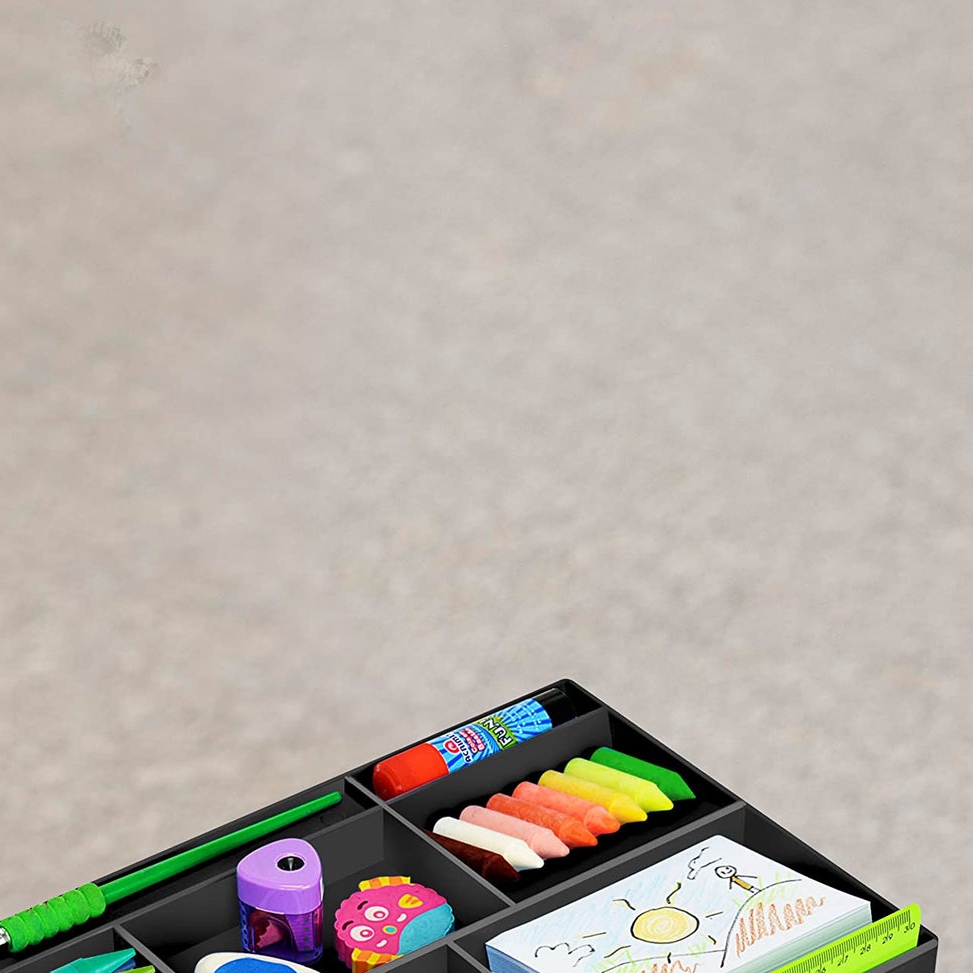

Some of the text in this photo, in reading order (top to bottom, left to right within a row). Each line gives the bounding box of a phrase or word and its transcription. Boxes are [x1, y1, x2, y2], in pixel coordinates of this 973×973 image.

[837, 954, 848, 966] 27
[860, 944, 871, 955] 28
[882, 933, 894, 944] 29
[903, 921, 915, 934] 30
